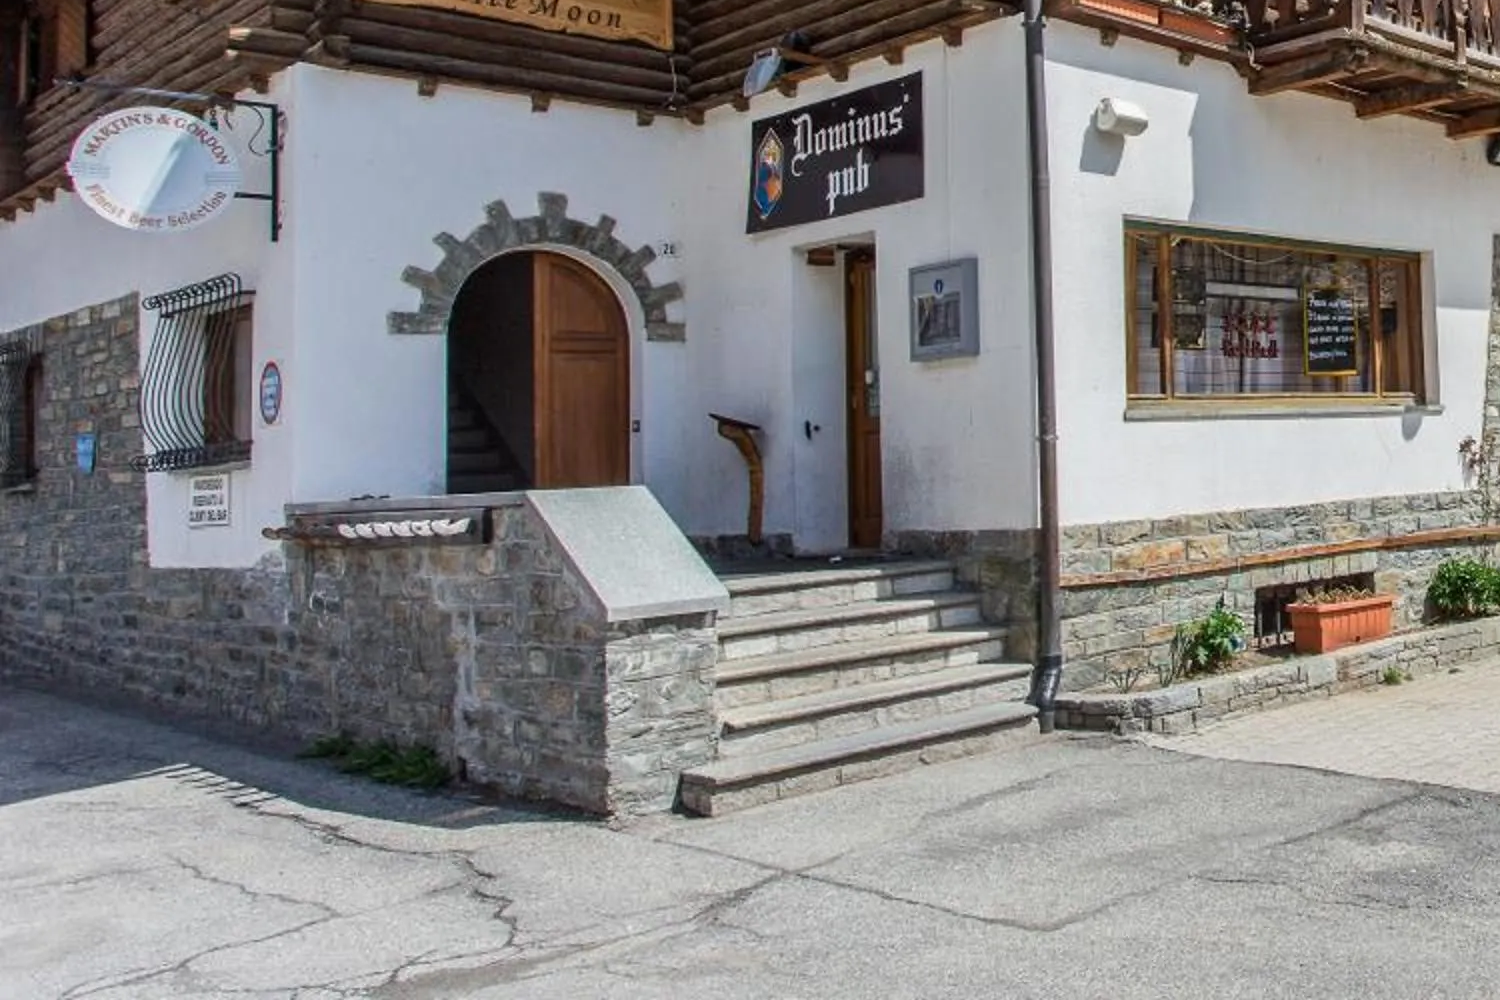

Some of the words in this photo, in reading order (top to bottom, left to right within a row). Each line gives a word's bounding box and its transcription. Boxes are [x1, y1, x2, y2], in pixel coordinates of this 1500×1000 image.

[156, 114, 172, 126] &
[173, 116, 231, 166] GORDON
[85, 183, 126, 218] Finest
[167, 191, 227, 228] Selection
[826, 147, 871, 216] pub
